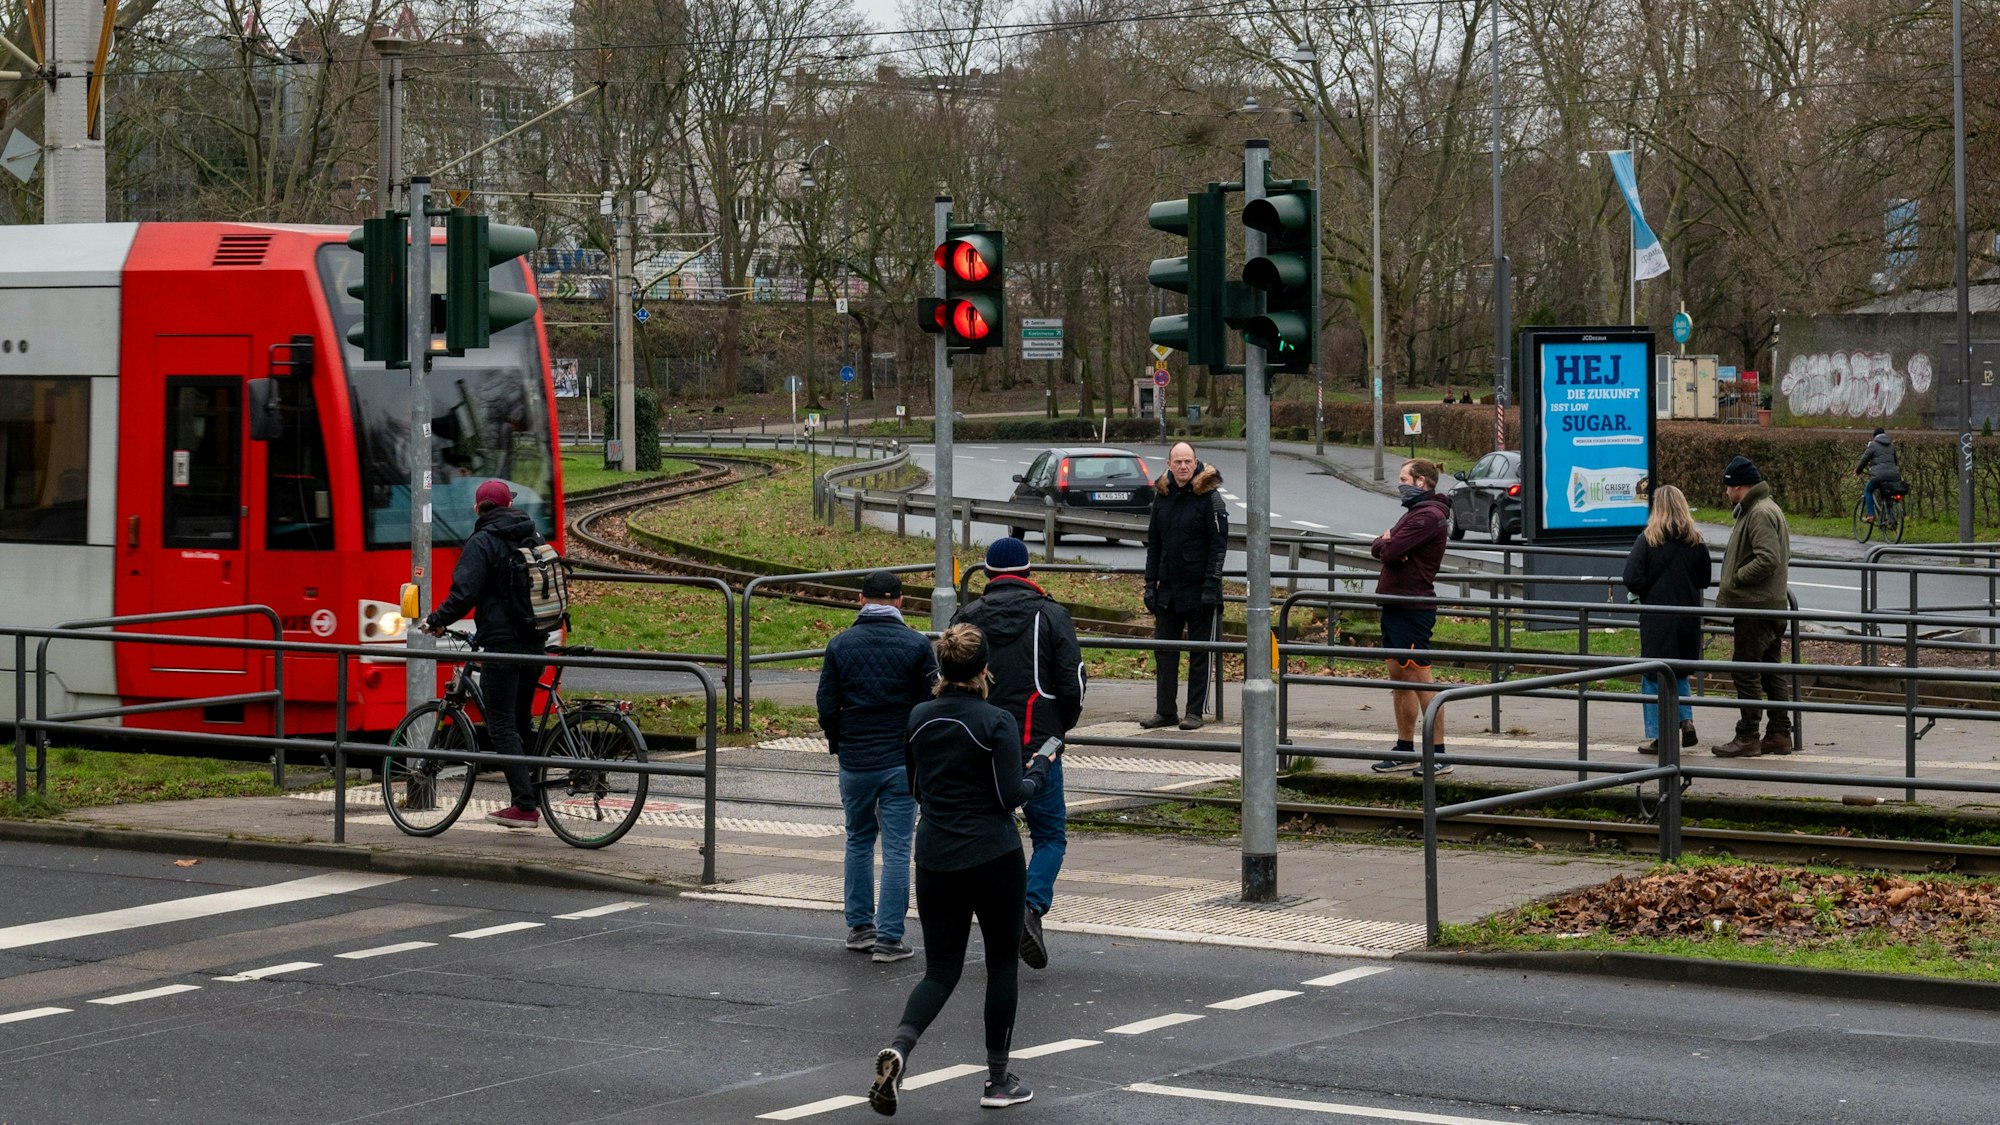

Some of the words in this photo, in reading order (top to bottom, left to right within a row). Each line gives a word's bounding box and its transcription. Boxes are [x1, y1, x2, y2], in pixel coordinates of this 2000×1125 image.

[840, 300, 844, 310] 2
[1567, 389, 1585, 400] DIE
[1587, 388, 1640, 400] ZUKUNFT
[1550, 402, 1569, 412] ISST
[1570, 402, 1589, 412] LOW
[1562, 414, 1631, 432] SUGAR.
[1604, 483, 1631, 491] CRISPY
